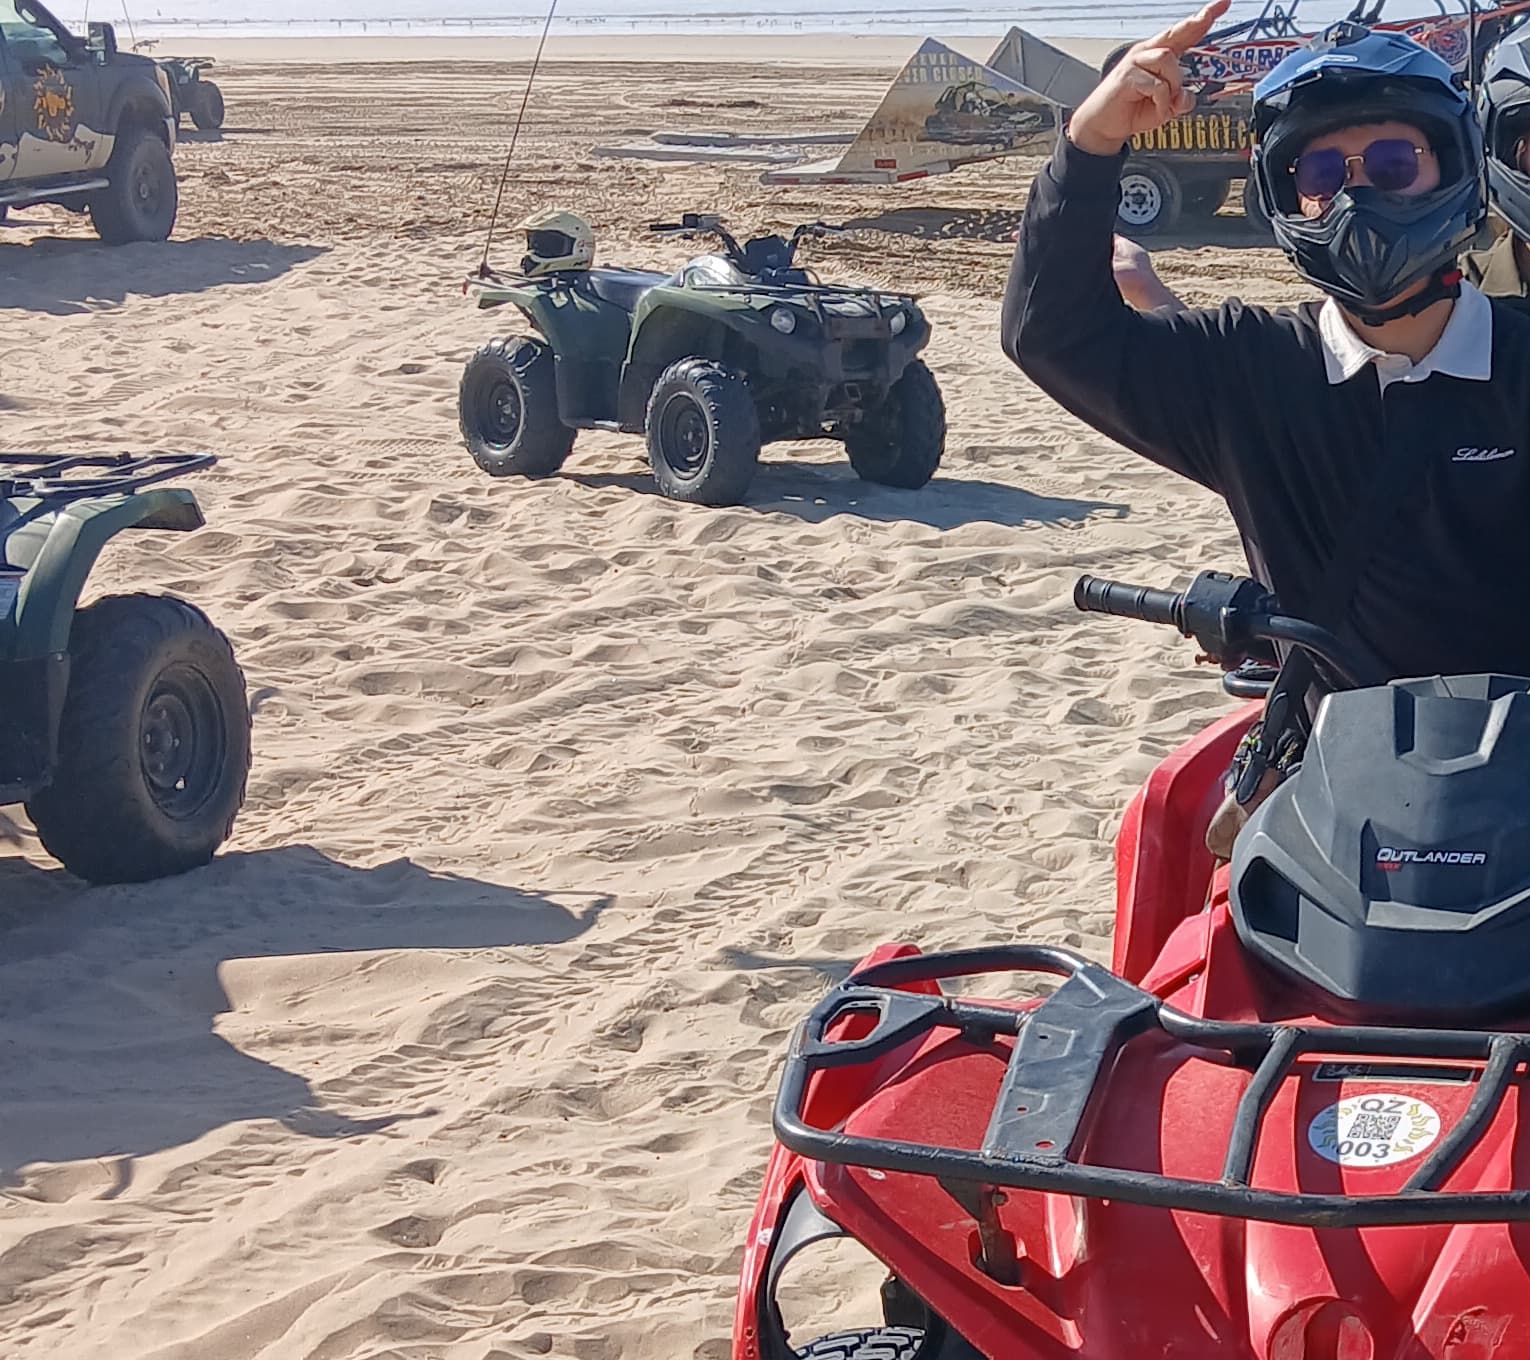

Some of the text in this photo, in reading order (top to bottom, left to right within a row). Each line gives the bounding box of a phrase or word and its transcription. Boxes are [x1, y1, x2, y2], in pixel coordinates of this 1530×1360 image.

[1376, 847, 1486, 865] OUTLANDER
[1360, 1098, 1408, 1115] QZ
[1336, 1140, 1391, 1159] 003
